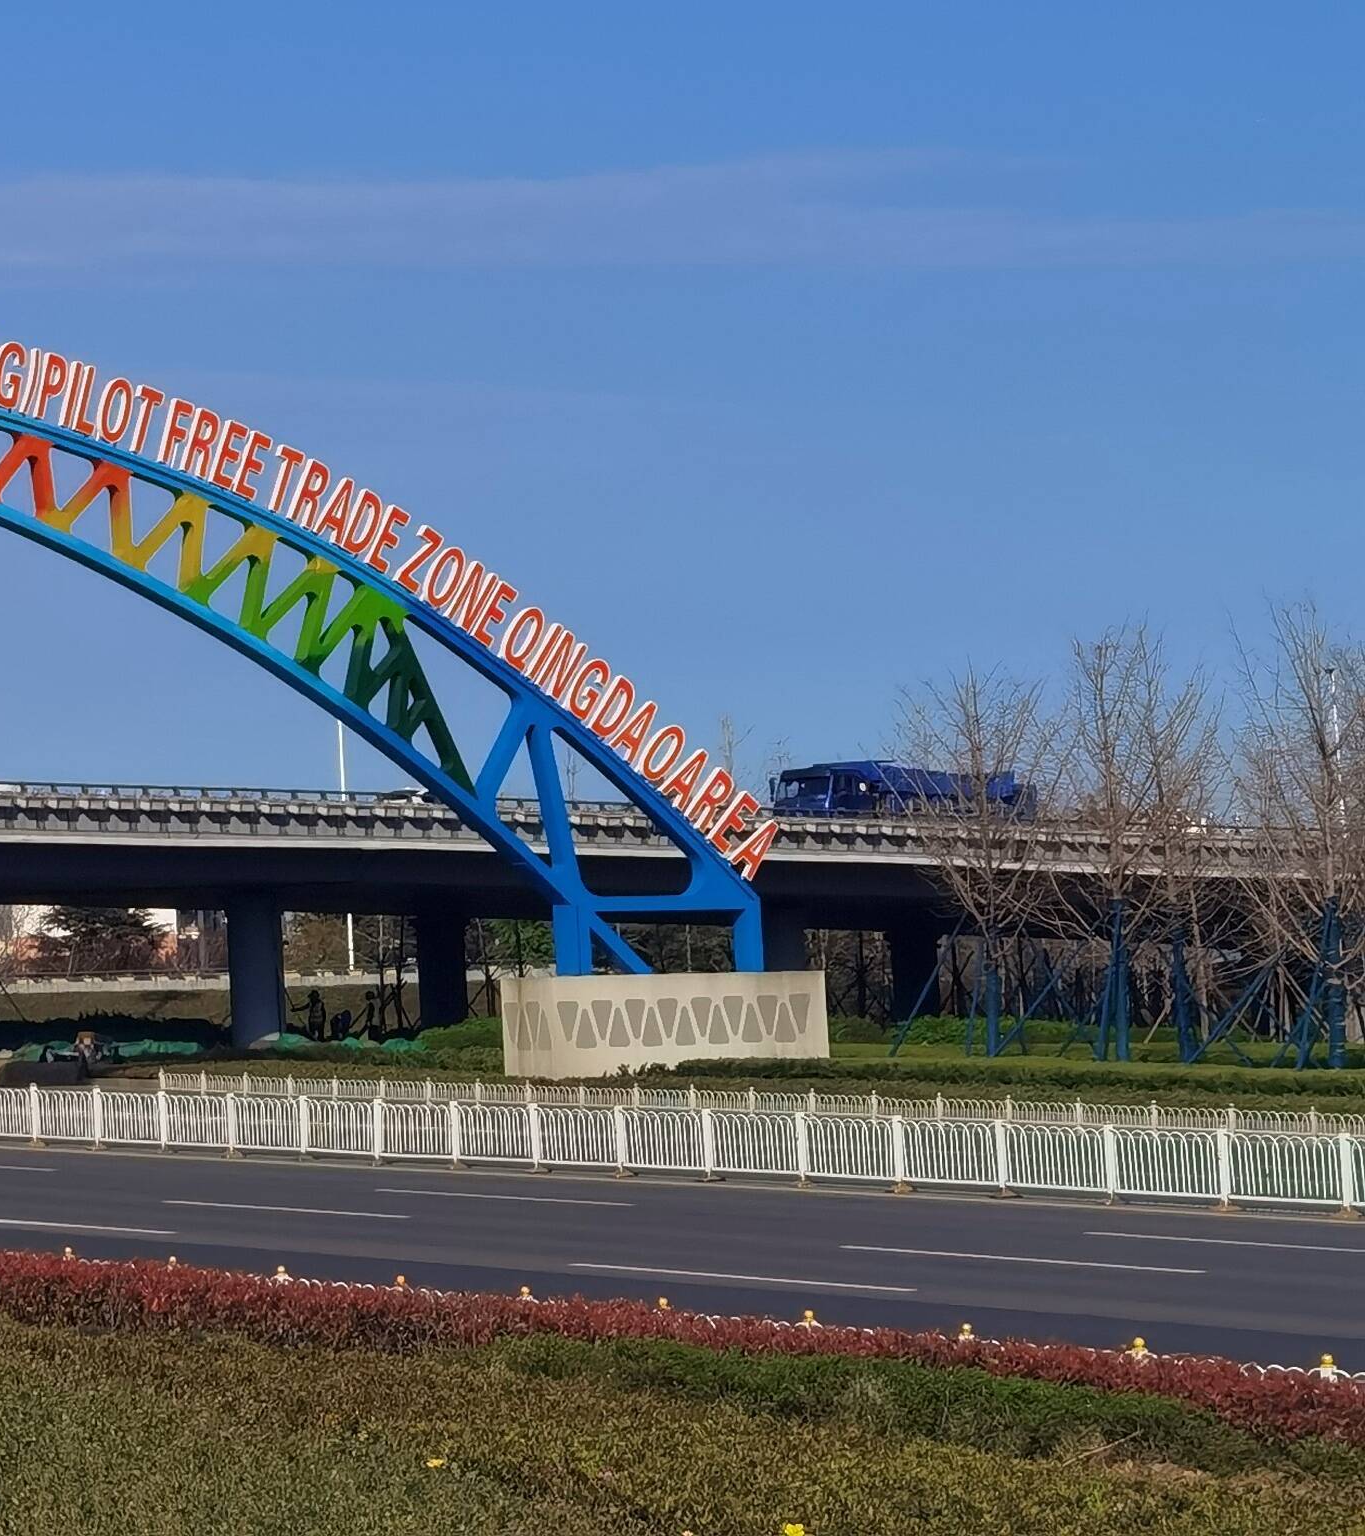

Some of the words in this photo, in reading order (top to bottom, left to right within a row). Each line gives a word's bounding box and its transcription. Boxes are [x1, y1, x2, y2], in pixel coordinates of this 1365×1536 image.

[156, 397, 273, 502] FREE
[268, 443, 411, 574] TRADE
[393, 524, 518, 648] ZONE
